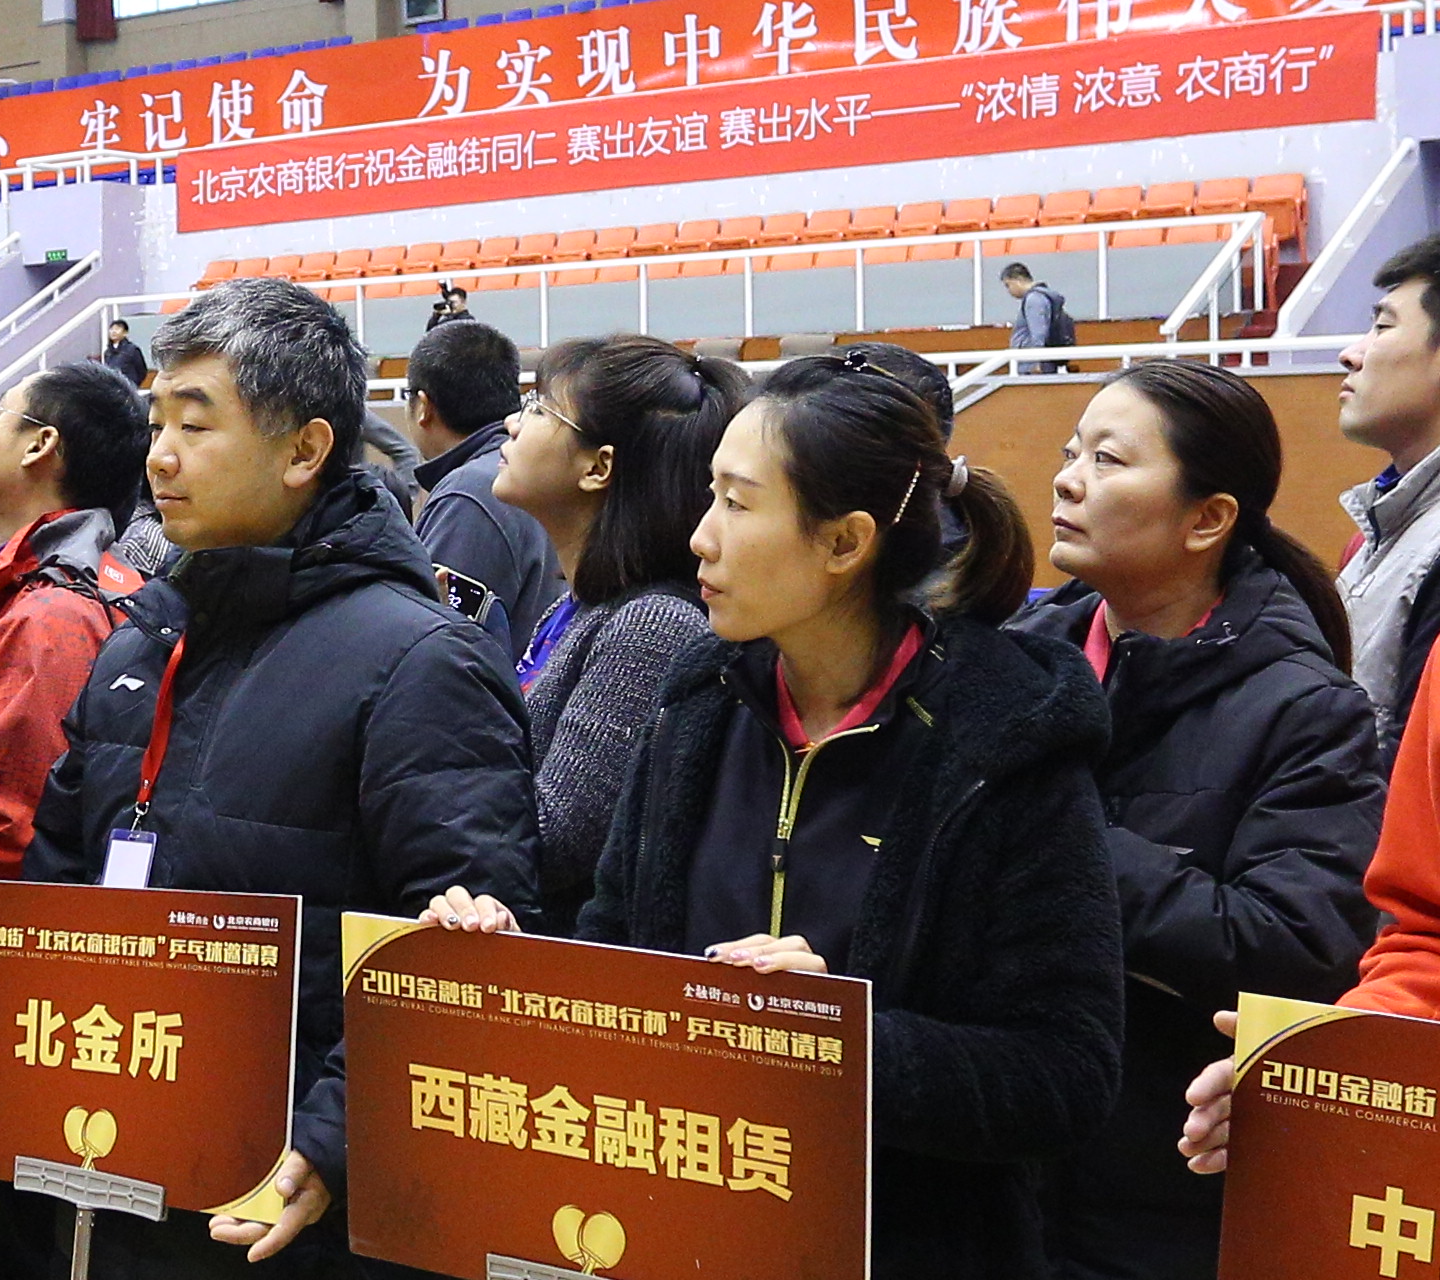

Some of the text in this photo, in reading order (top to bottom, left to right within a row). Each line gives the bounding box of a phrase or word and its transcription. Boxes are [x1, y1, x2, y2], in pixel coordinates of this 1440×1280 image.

[80, 69, 328, 152] 牢记使命
[191, 131, 558, 206] 北京农商银行祝金融街同仁
[567, 110, 708, 166] 赛出友谊
[1073, 61, 1162, 115] 浓意
[14, 997, 183, 1082] 北金所
[408, 1062, 794, 1202] 西藏金融租赁
[1314, 1102, 1350, 1117] RURAL
[1355, 1109, 1438, 1133] COMMERCIAL
